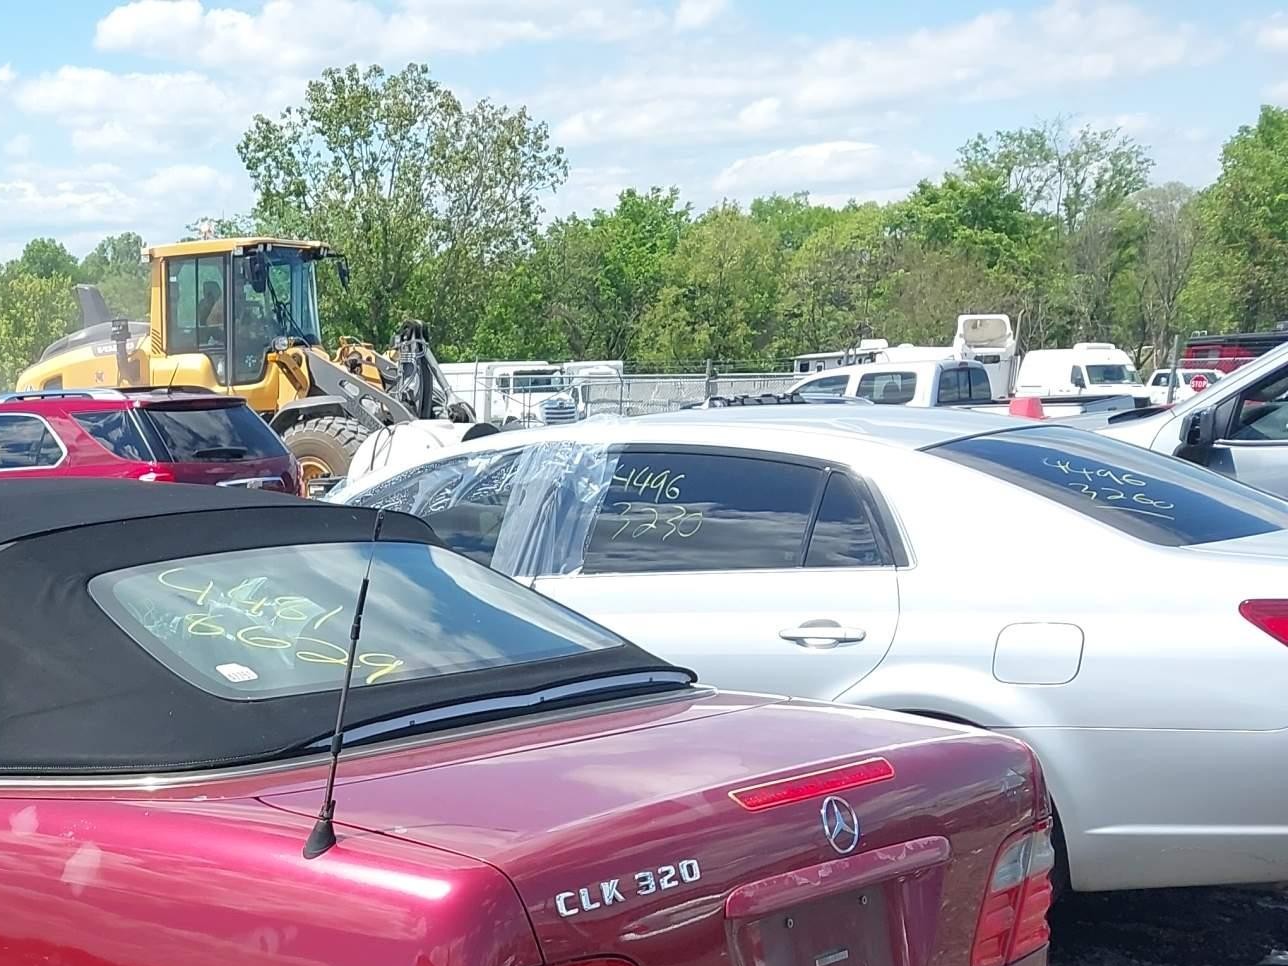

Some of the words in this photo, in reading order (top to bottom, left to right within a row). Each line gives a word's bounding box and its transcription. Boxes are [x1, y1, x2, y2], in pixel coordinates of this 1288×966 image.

[96, 341, 135, 354] VOLO
[612, 464, 686, 504] 4496
[1041, 457, 1148, 487] 4496
[611, 502, 704, 541] 3230
[184, 613, 404, 685] 8629
[555, 878, 626, 918] CLK
[634, 859, 701, 896] 320
